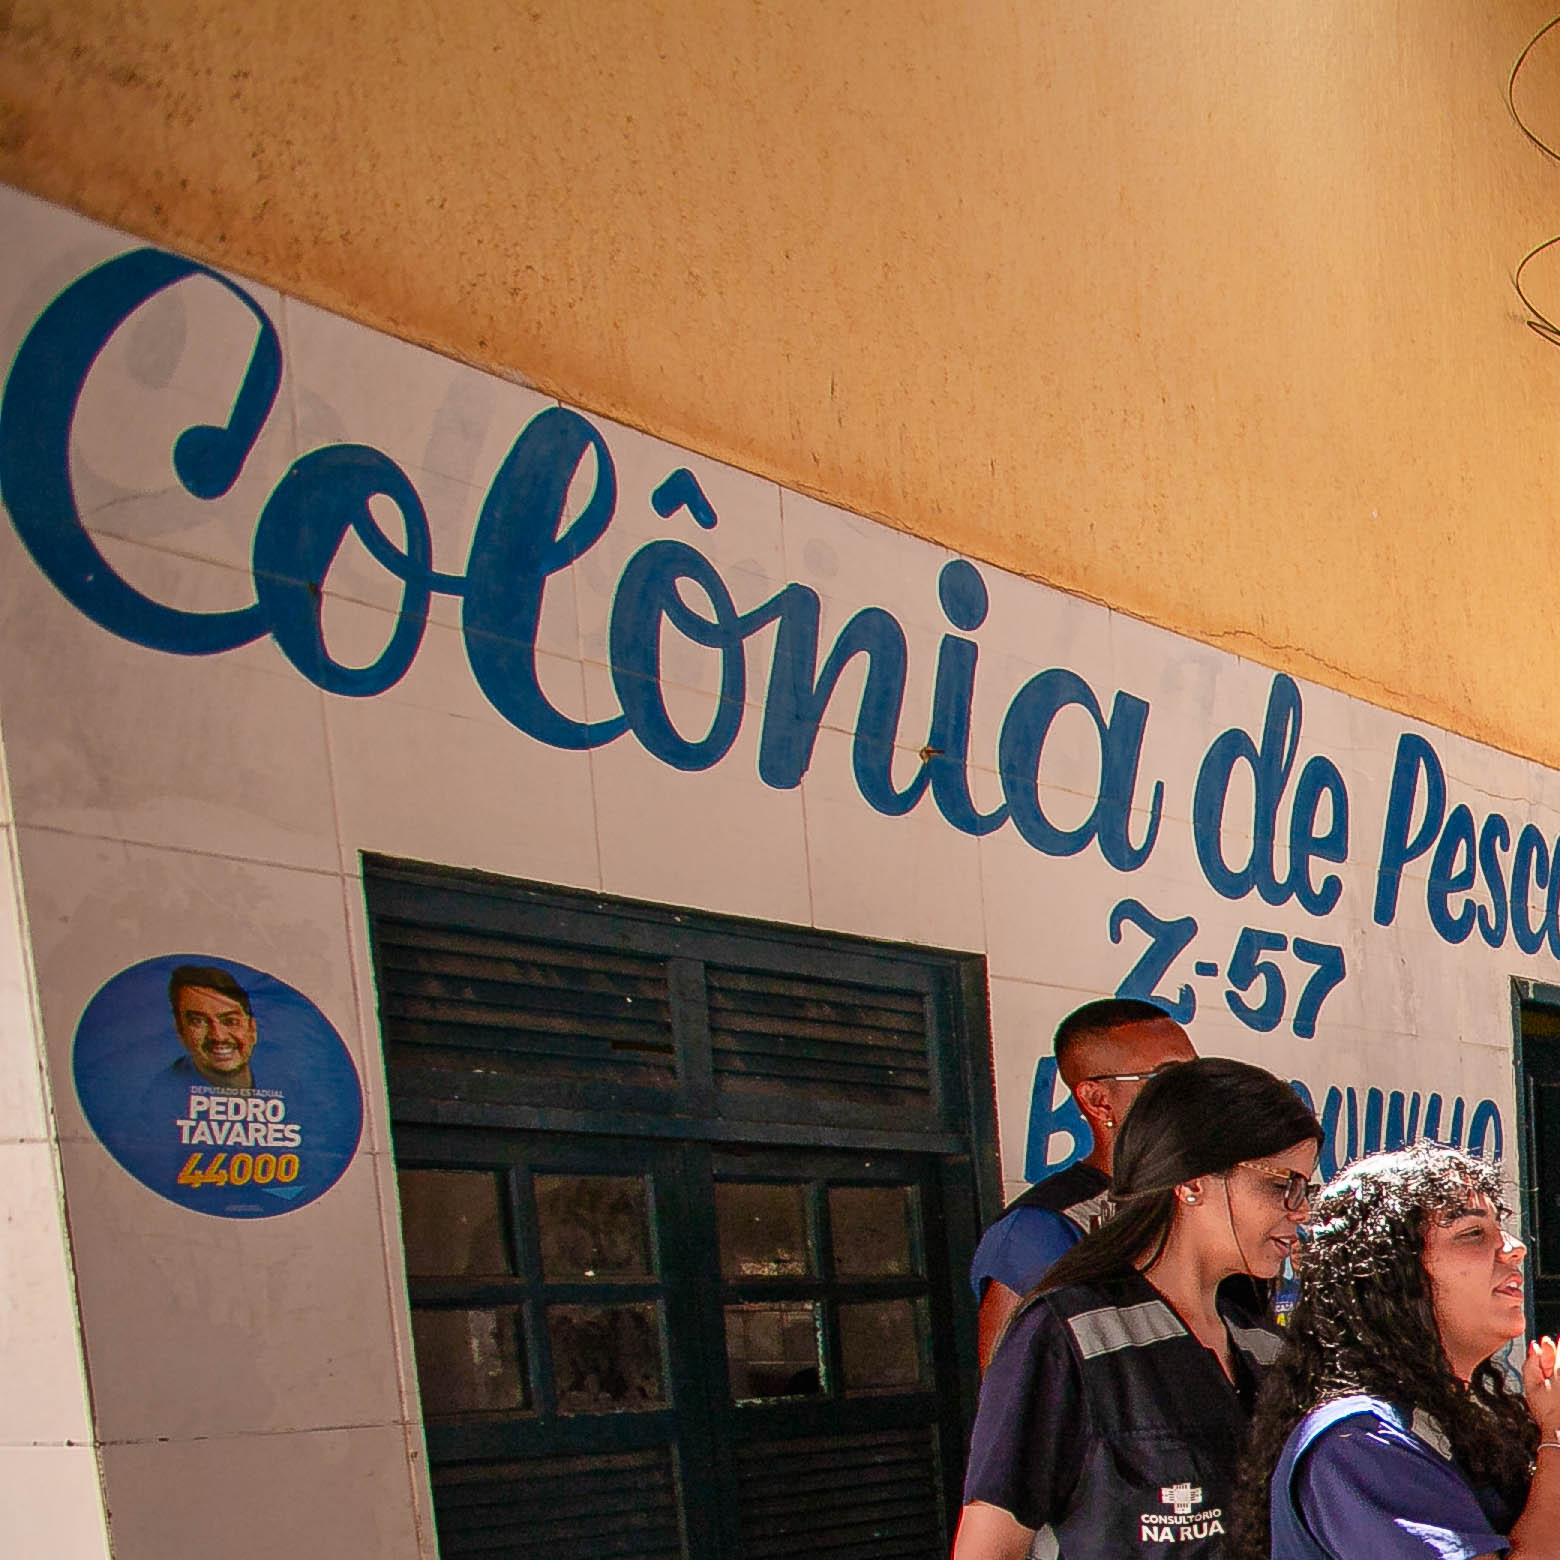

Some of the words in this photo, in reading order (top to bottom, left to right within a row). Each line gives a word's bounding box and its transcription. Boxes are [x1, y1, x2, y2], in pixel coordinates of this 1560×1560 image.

[0, 247, 1163, 872] Colônia
[1194, 672, 1349, 917] de
[1108, 897, 1347, 1040] Z-57
[188, 1095, 286, 1123] PEDRO
[176, 1119, 302, 1148] TAVARES
[177, 1152, 300, 1188] 44000
[1141, 1525, 1175, 1543] NA
[1180, 1520, 1225, 1541] RUA
